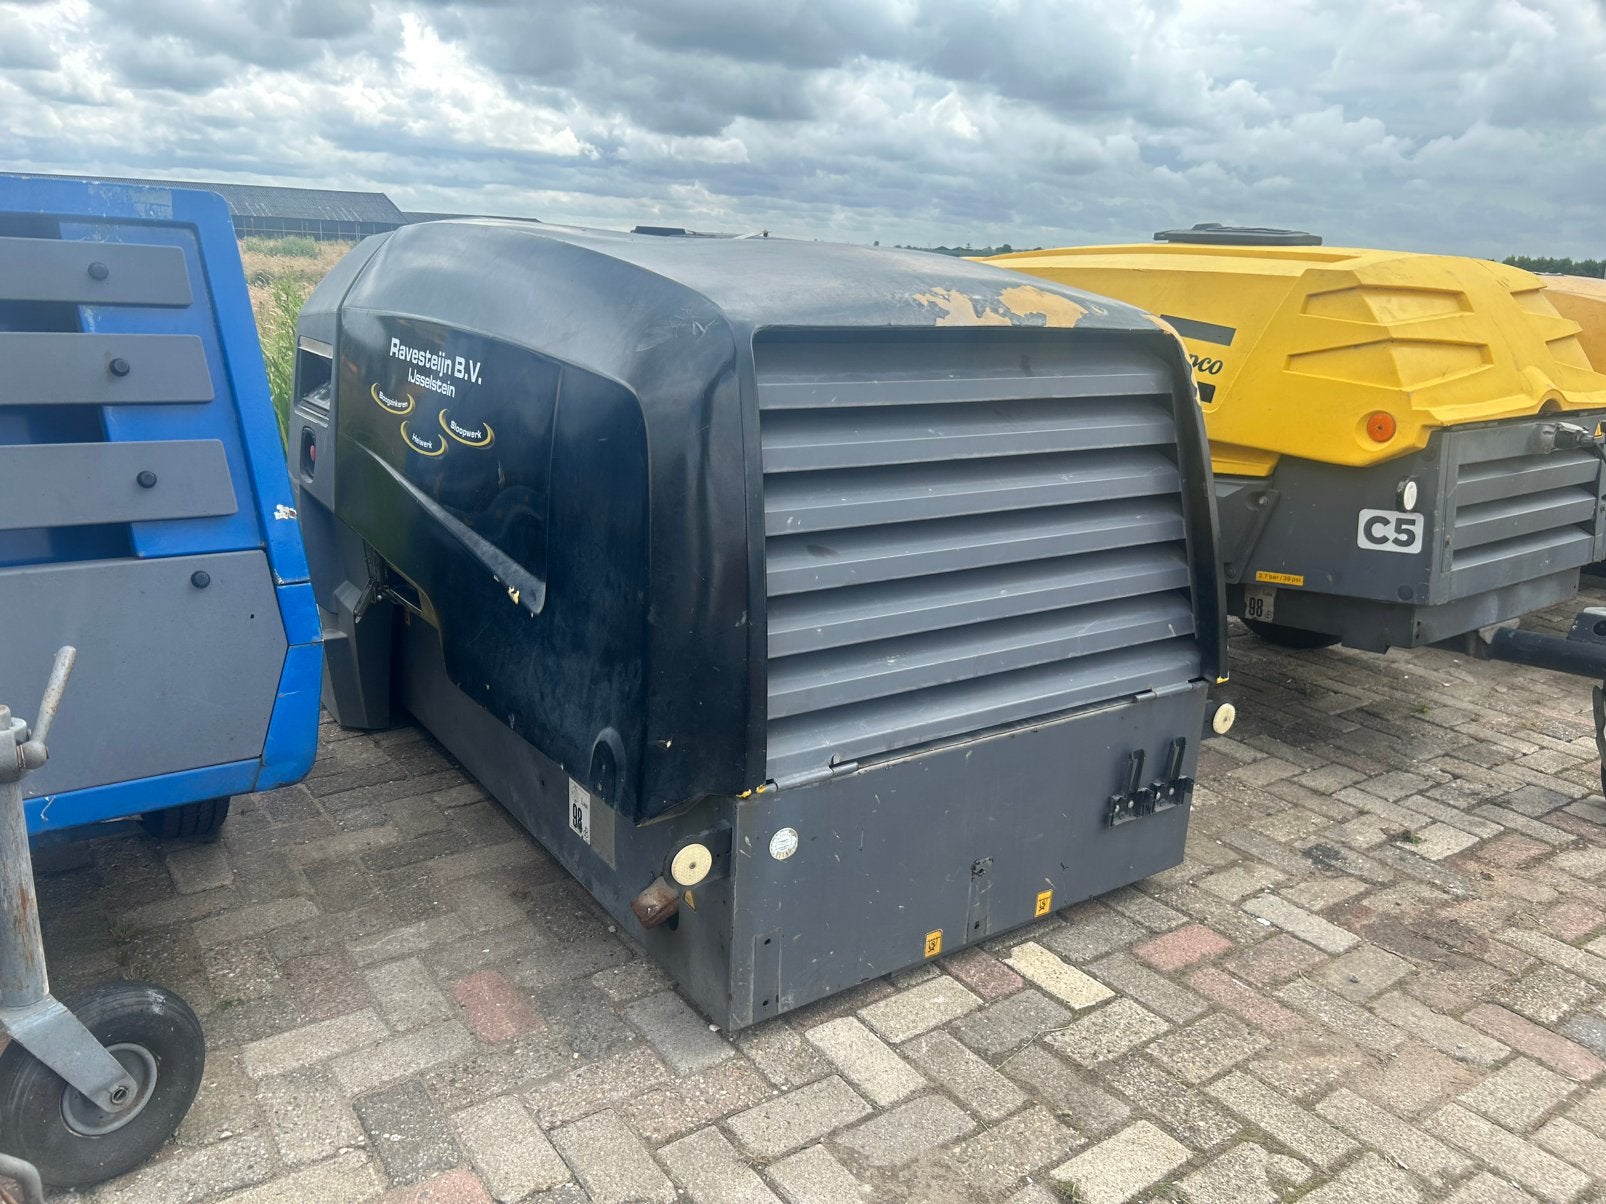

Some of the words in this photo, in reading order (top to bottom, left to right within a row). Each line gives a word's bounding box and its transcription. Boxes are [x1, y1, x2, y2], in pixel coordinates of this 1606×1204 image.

[390, 337, 452, 377] Ravesteijn
[454, 356, 482, 385] B.V.
[407, 367, 456, 398] IJsselstein
[411, 432, 433, 449] Heiwerk
[449, 420, 482, 439] Sloopwerk
[1363, 515, 1416, 547] C5
[1249, 597, 1263, 617] 98
